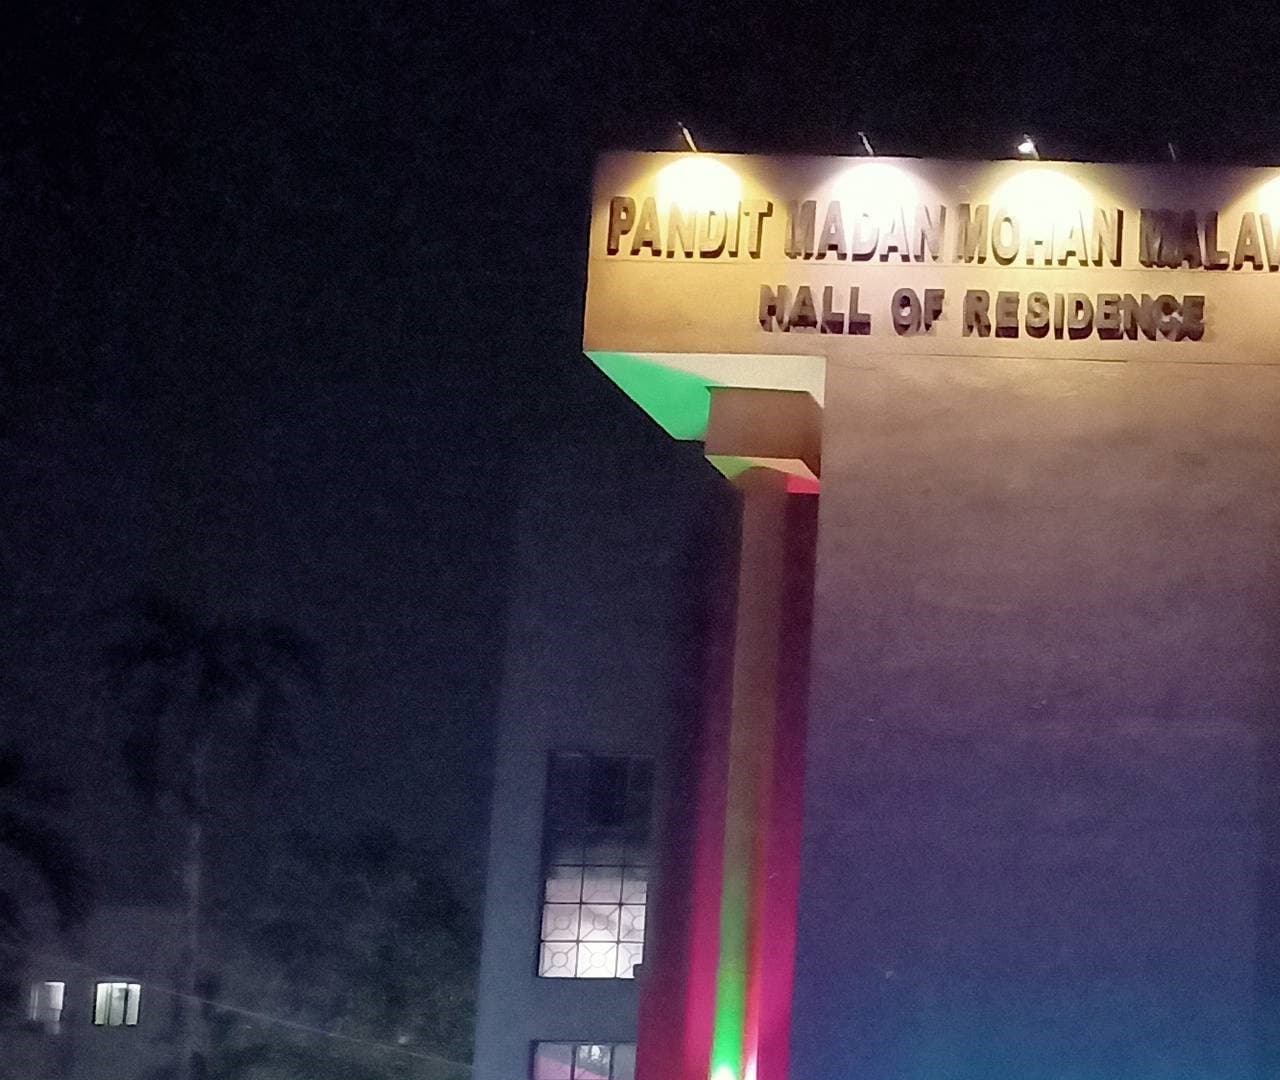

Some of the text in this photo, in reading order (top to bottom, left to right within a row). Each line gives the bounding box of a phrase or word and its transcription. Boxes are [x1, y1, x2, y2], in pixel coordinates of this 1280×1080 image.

[606, 195, 773, 260] PANDIT
[784, 199, 947, 264] MADAN
[954, 202, 1124, 268] MOHAN
[758, 283, 1206, 342] HALL OF RESIDENCE
